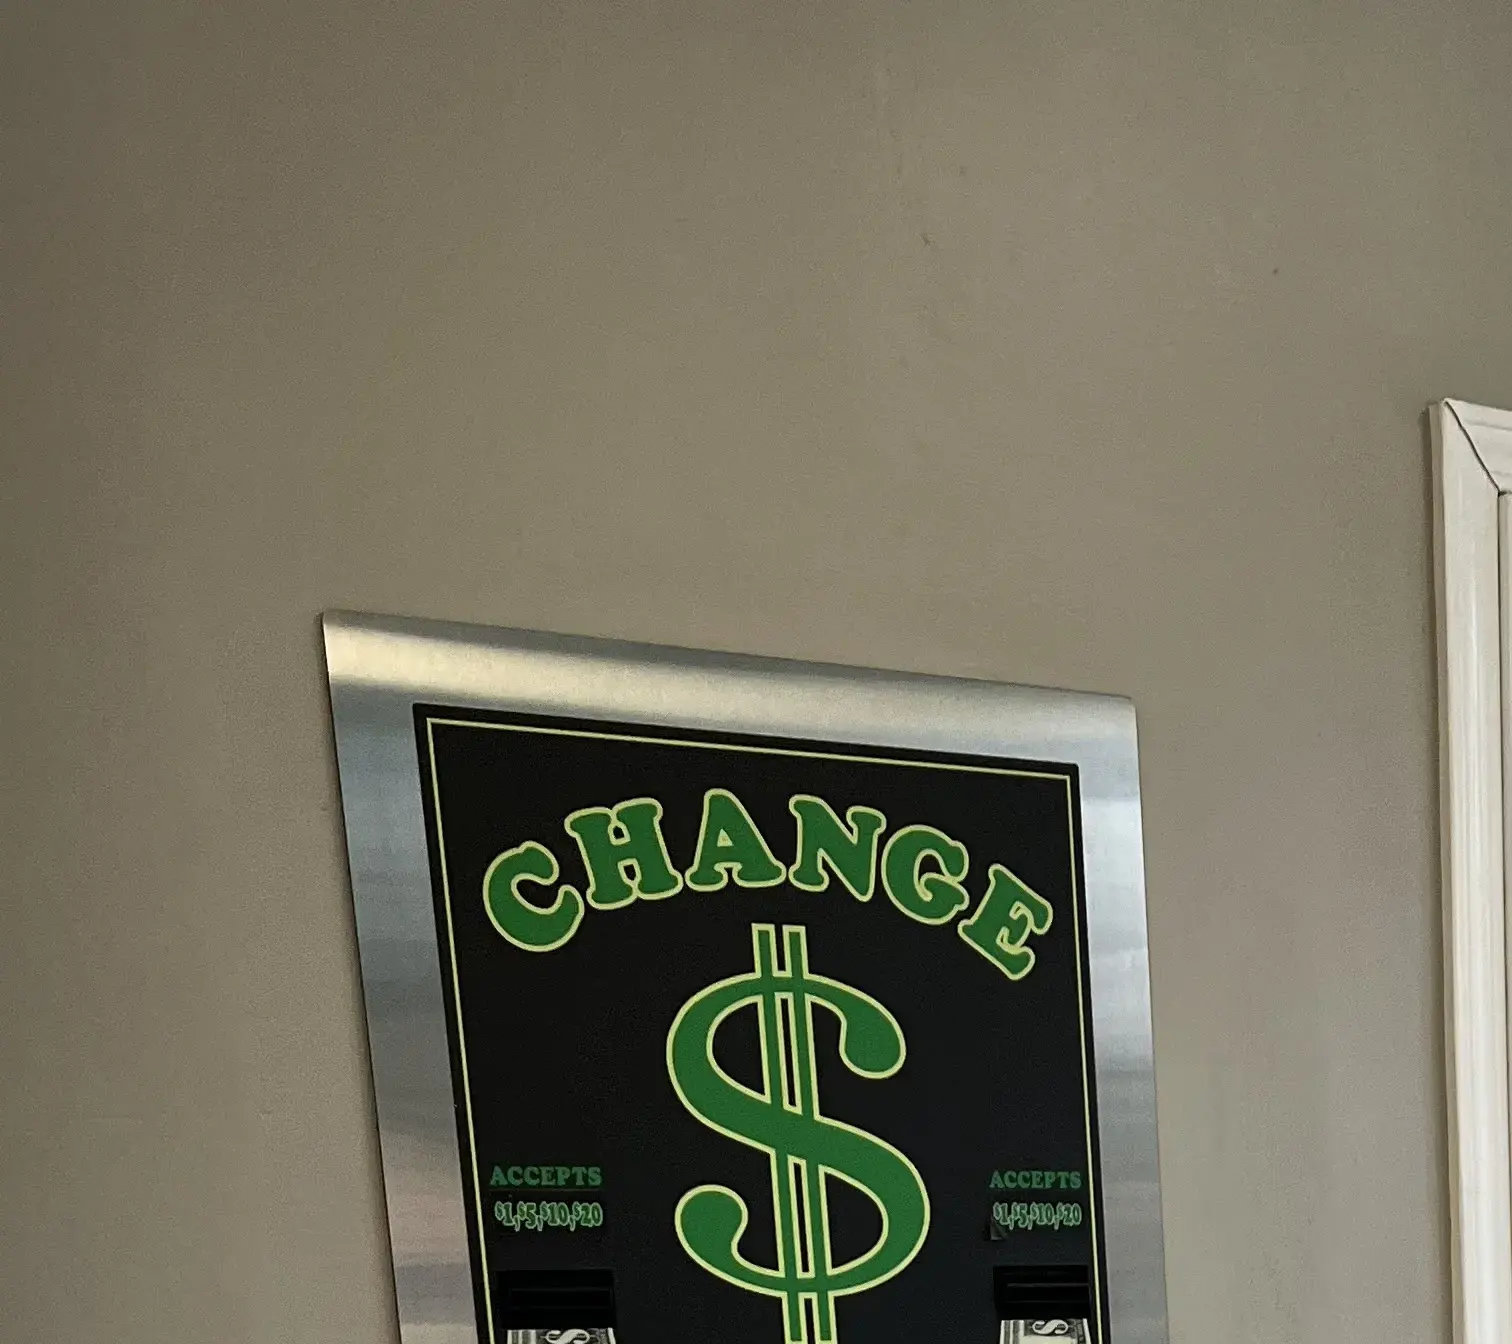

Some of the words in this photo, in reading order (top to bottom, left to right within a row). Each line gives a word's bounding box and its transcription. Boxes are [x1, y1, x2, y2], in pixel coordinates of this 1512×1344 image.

[483, 788, 1054, 981] CHANGE
[490, 1165, 602, 1187] ACCEPTS
[989, 1169, 1082, 1189] ACCEPTS
